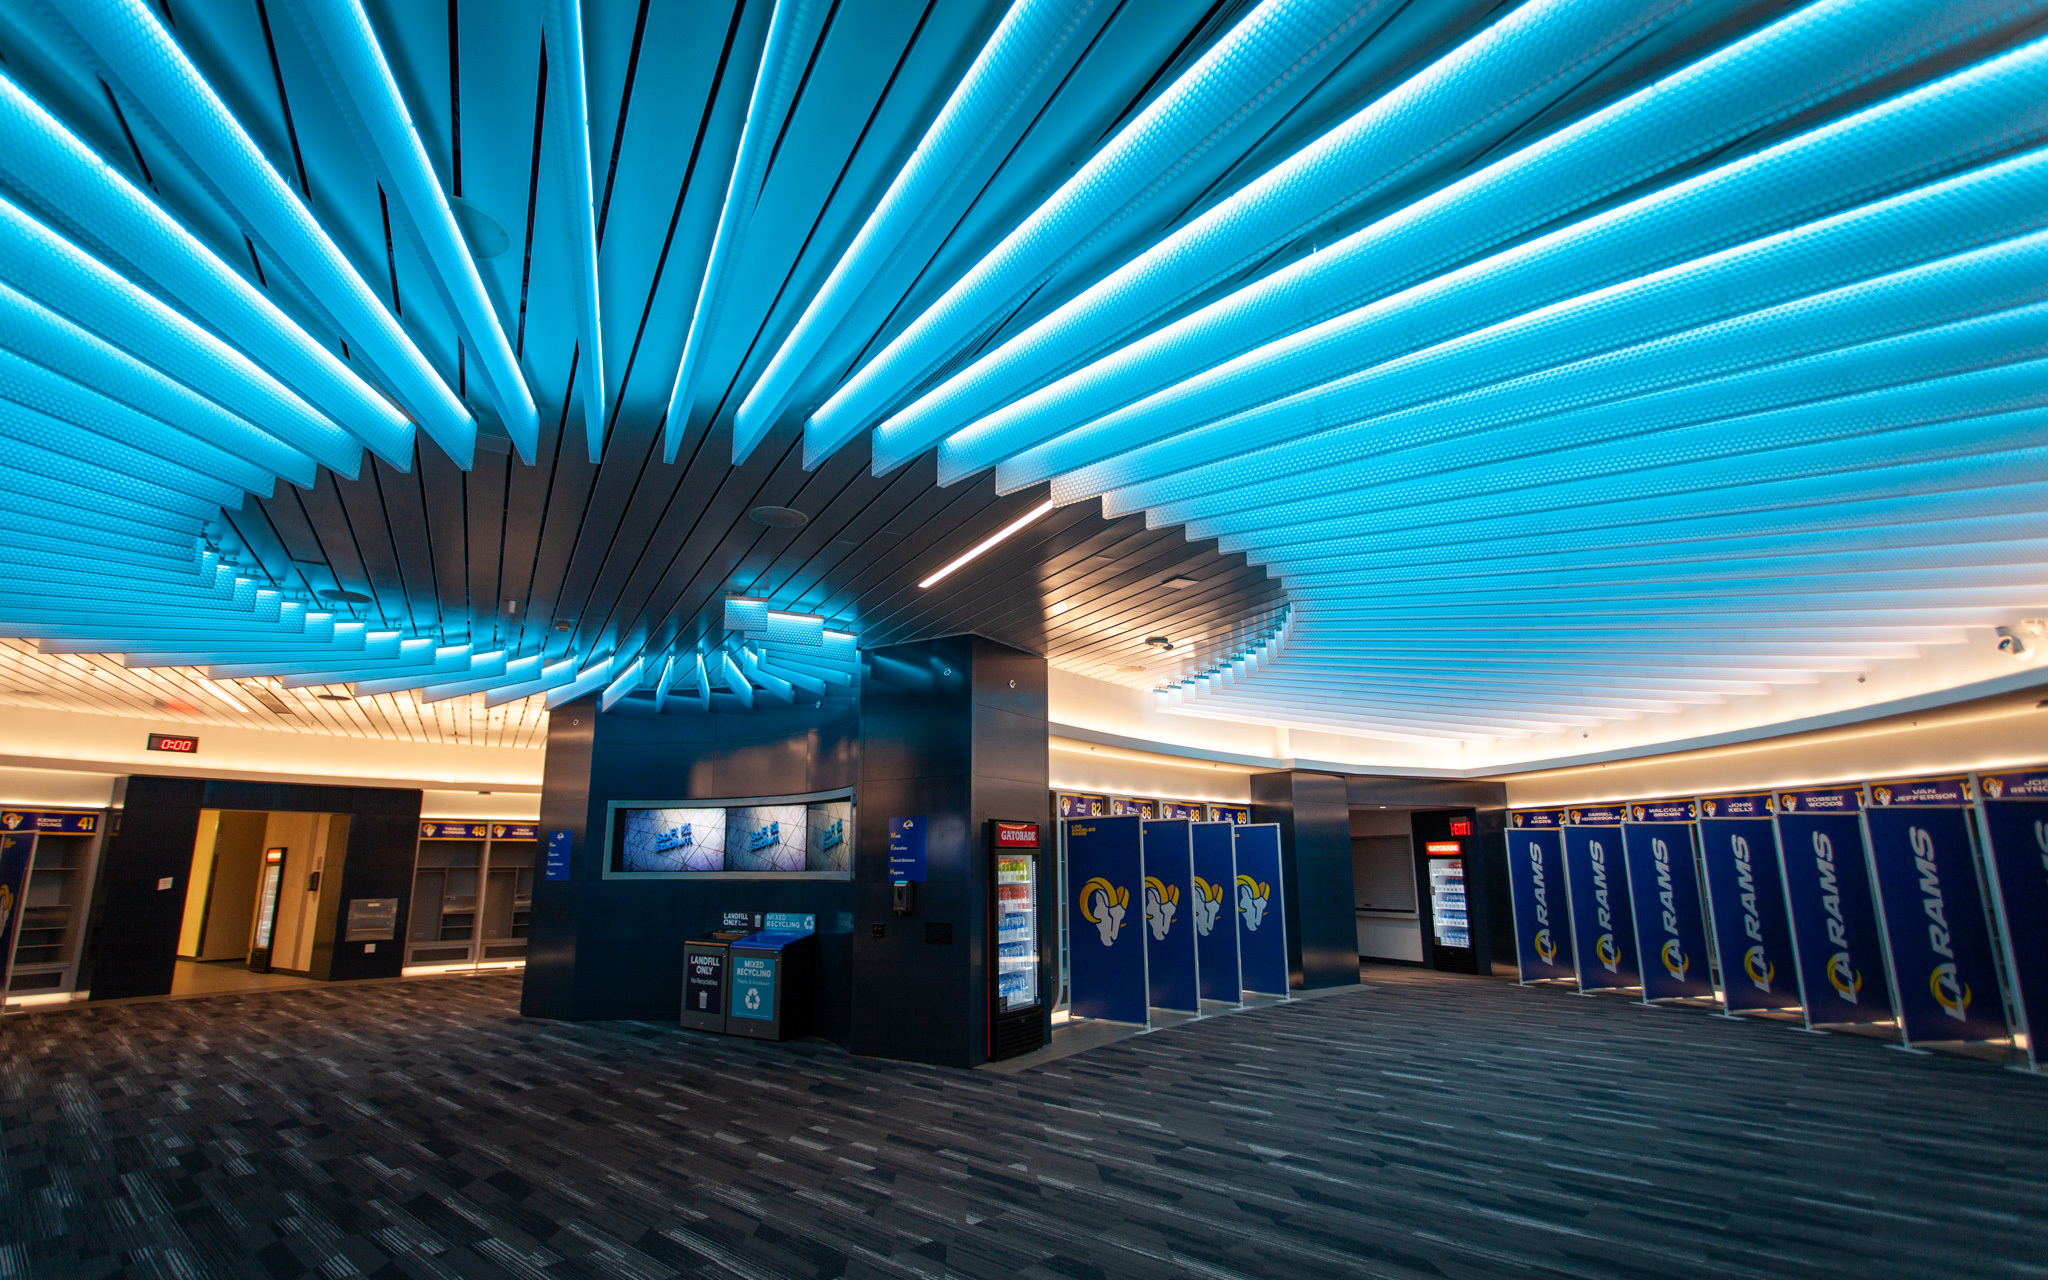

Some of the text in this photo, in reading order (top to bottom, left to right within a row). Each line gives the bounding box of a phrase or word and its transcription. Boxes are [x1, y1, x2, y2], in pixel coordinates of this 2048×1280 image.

[160, 739, 192, 751] 0:00
[1806, 795, 1843, 803] ROBERT
[1895, 792, 1957, 802] JEFFERSON
[1091, 802, 1102, 817] 82
[1142, 805, 1152, 819] 86
[1190, 809, 1200, 822] 88
[77, 817, 94, 830] 41
[1237, 812, 1247, 824] 89
[472, 825, 486, 837] 48
[1001, 830, 1036, 841] GATORADE
[655, 836, 693, 853] Stadium
[750, 834, 780, 852] Stadium
[1529, 842, 1549, 926] RAMS
[1589, 839, 1612, 931] RAMS
[1652, 837, 1679, 936] RAMS
[1731, 834, 1762, 943] RAMS
[1812, 830, 1849, 949] RAMS
[1909, 826, 1954, 960] RAMS
[723, 912, 748, 920] LANDFILL
[766, 920, 800, 928] RECYCLING
[690, 955, 720, 966] LANDFILL
[744, 960, 764, 968] MIXED
[696, 965, 713, 975] ONLY
[736, 968, 771, 978] RECYCLING
